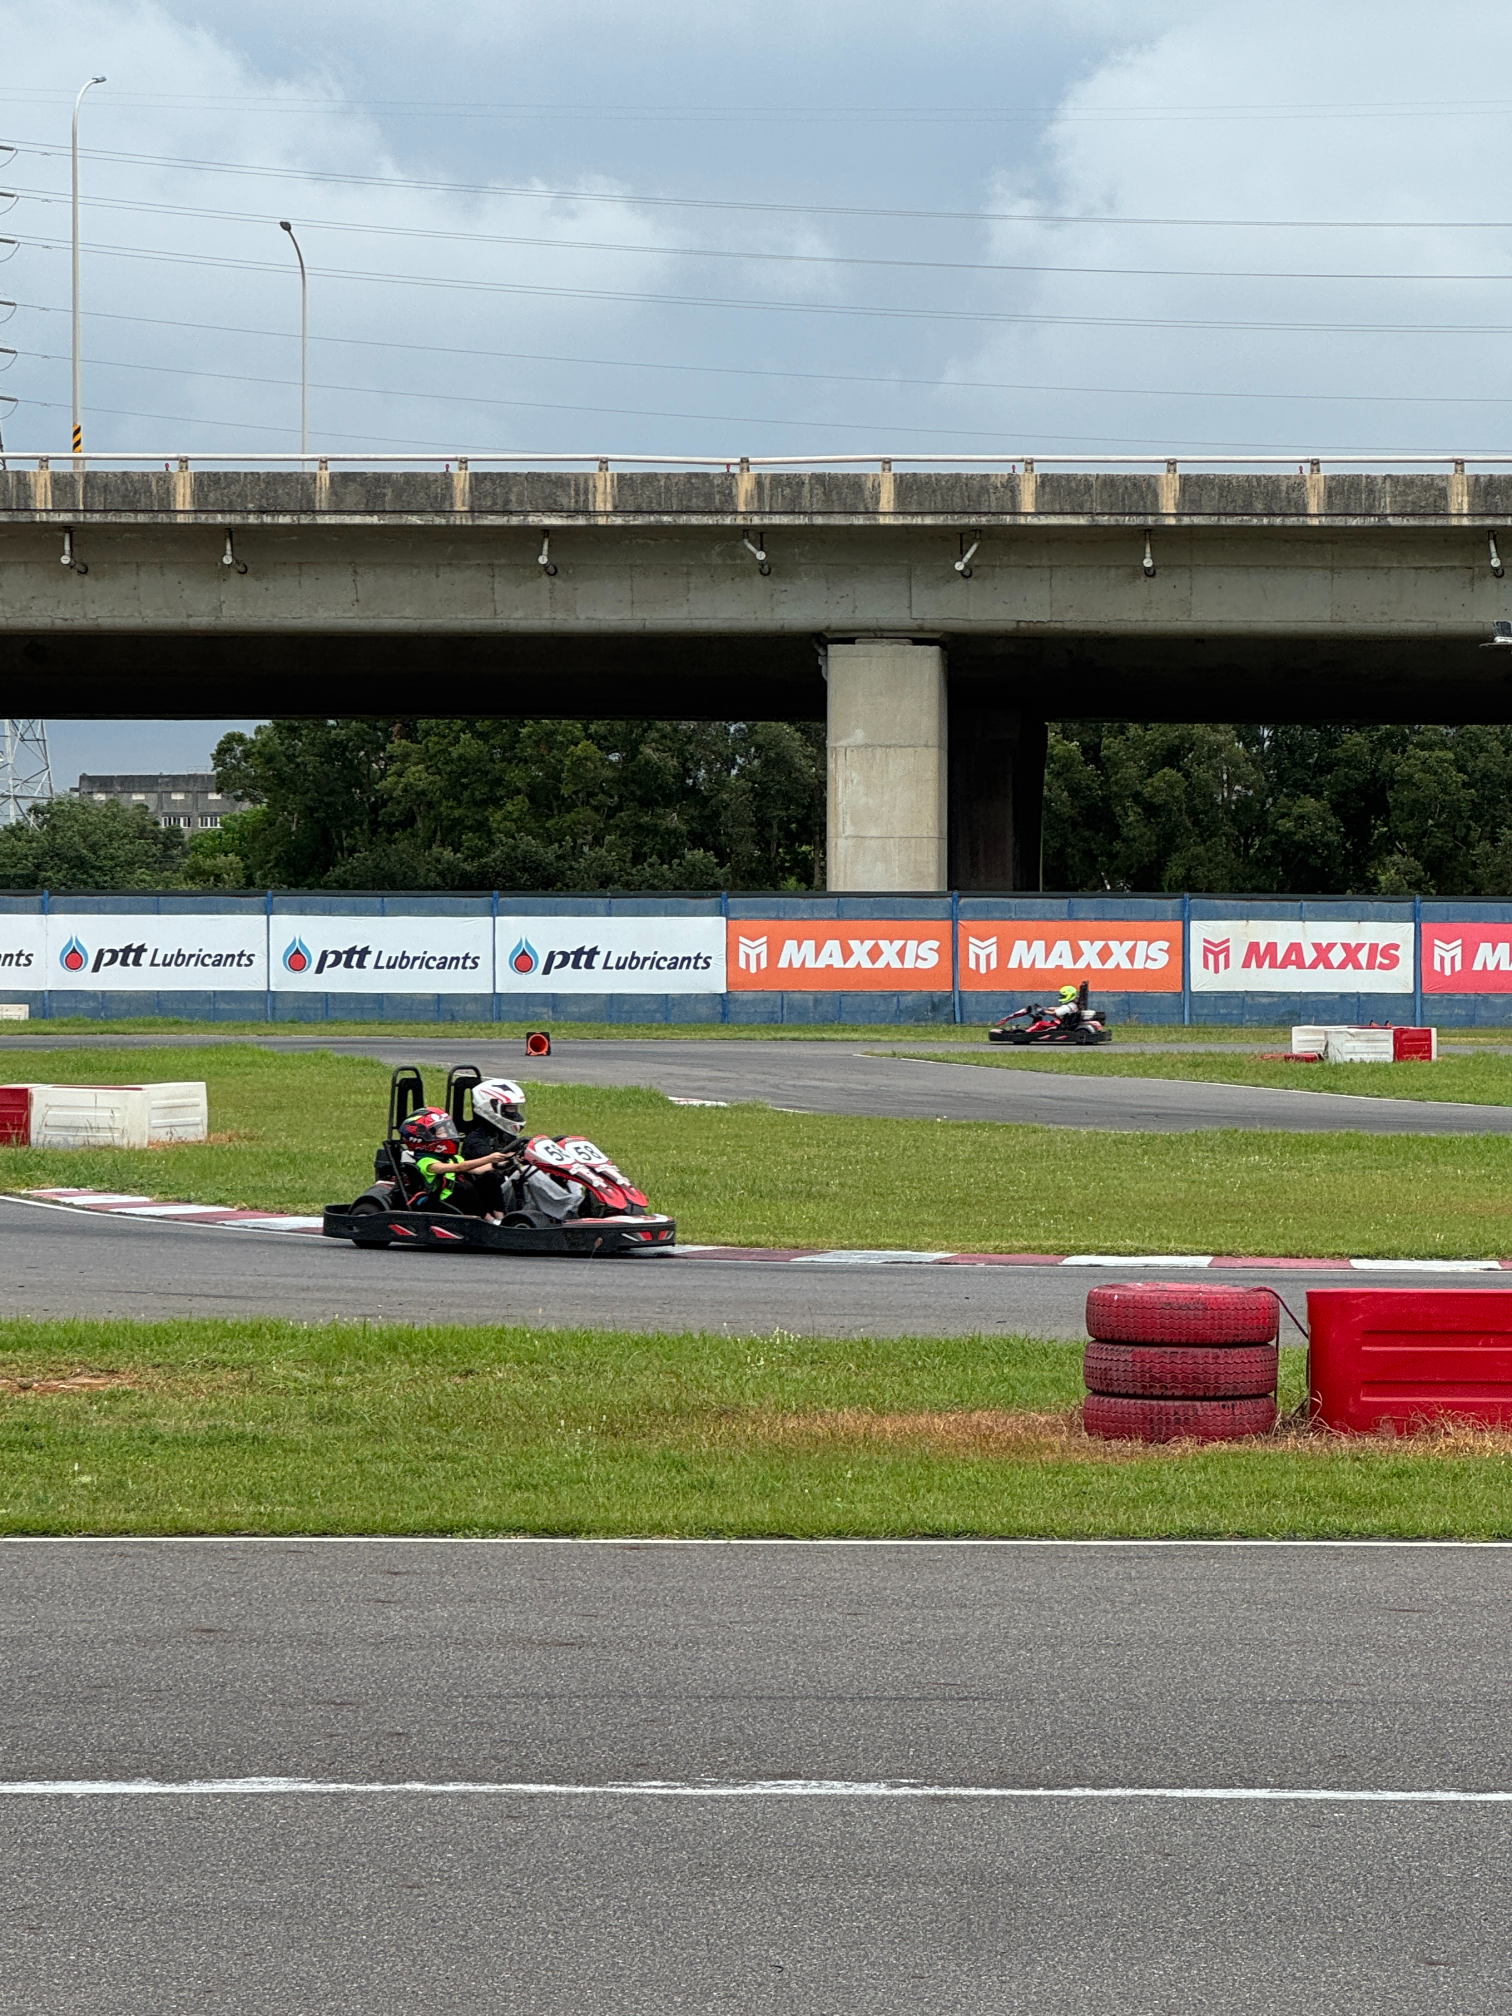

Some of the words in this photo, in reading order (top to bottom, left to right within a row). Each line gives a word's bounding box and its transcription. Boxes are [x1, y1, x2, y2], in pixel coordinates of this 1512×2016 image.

[0, 949, 34, 967] nts
[91, 943, 148, 973] ptt
[150, 948, 256, 968] Lubricants
[315, 944, 373, 975] ptt
[374, 950, 481, 970] Lubricants
[542, 945, 601, 976] ptt
[602, 950, 713, 971] Lubricants
[778, 939, 941, 969] MAXXIS
[1007, 940, 1170, 970] MAXXIS
[1241, 941, 1401, 971] MAXXIS
[1472, 942, 1512, 971] M
[573, 1145, 603, 1161] 58
